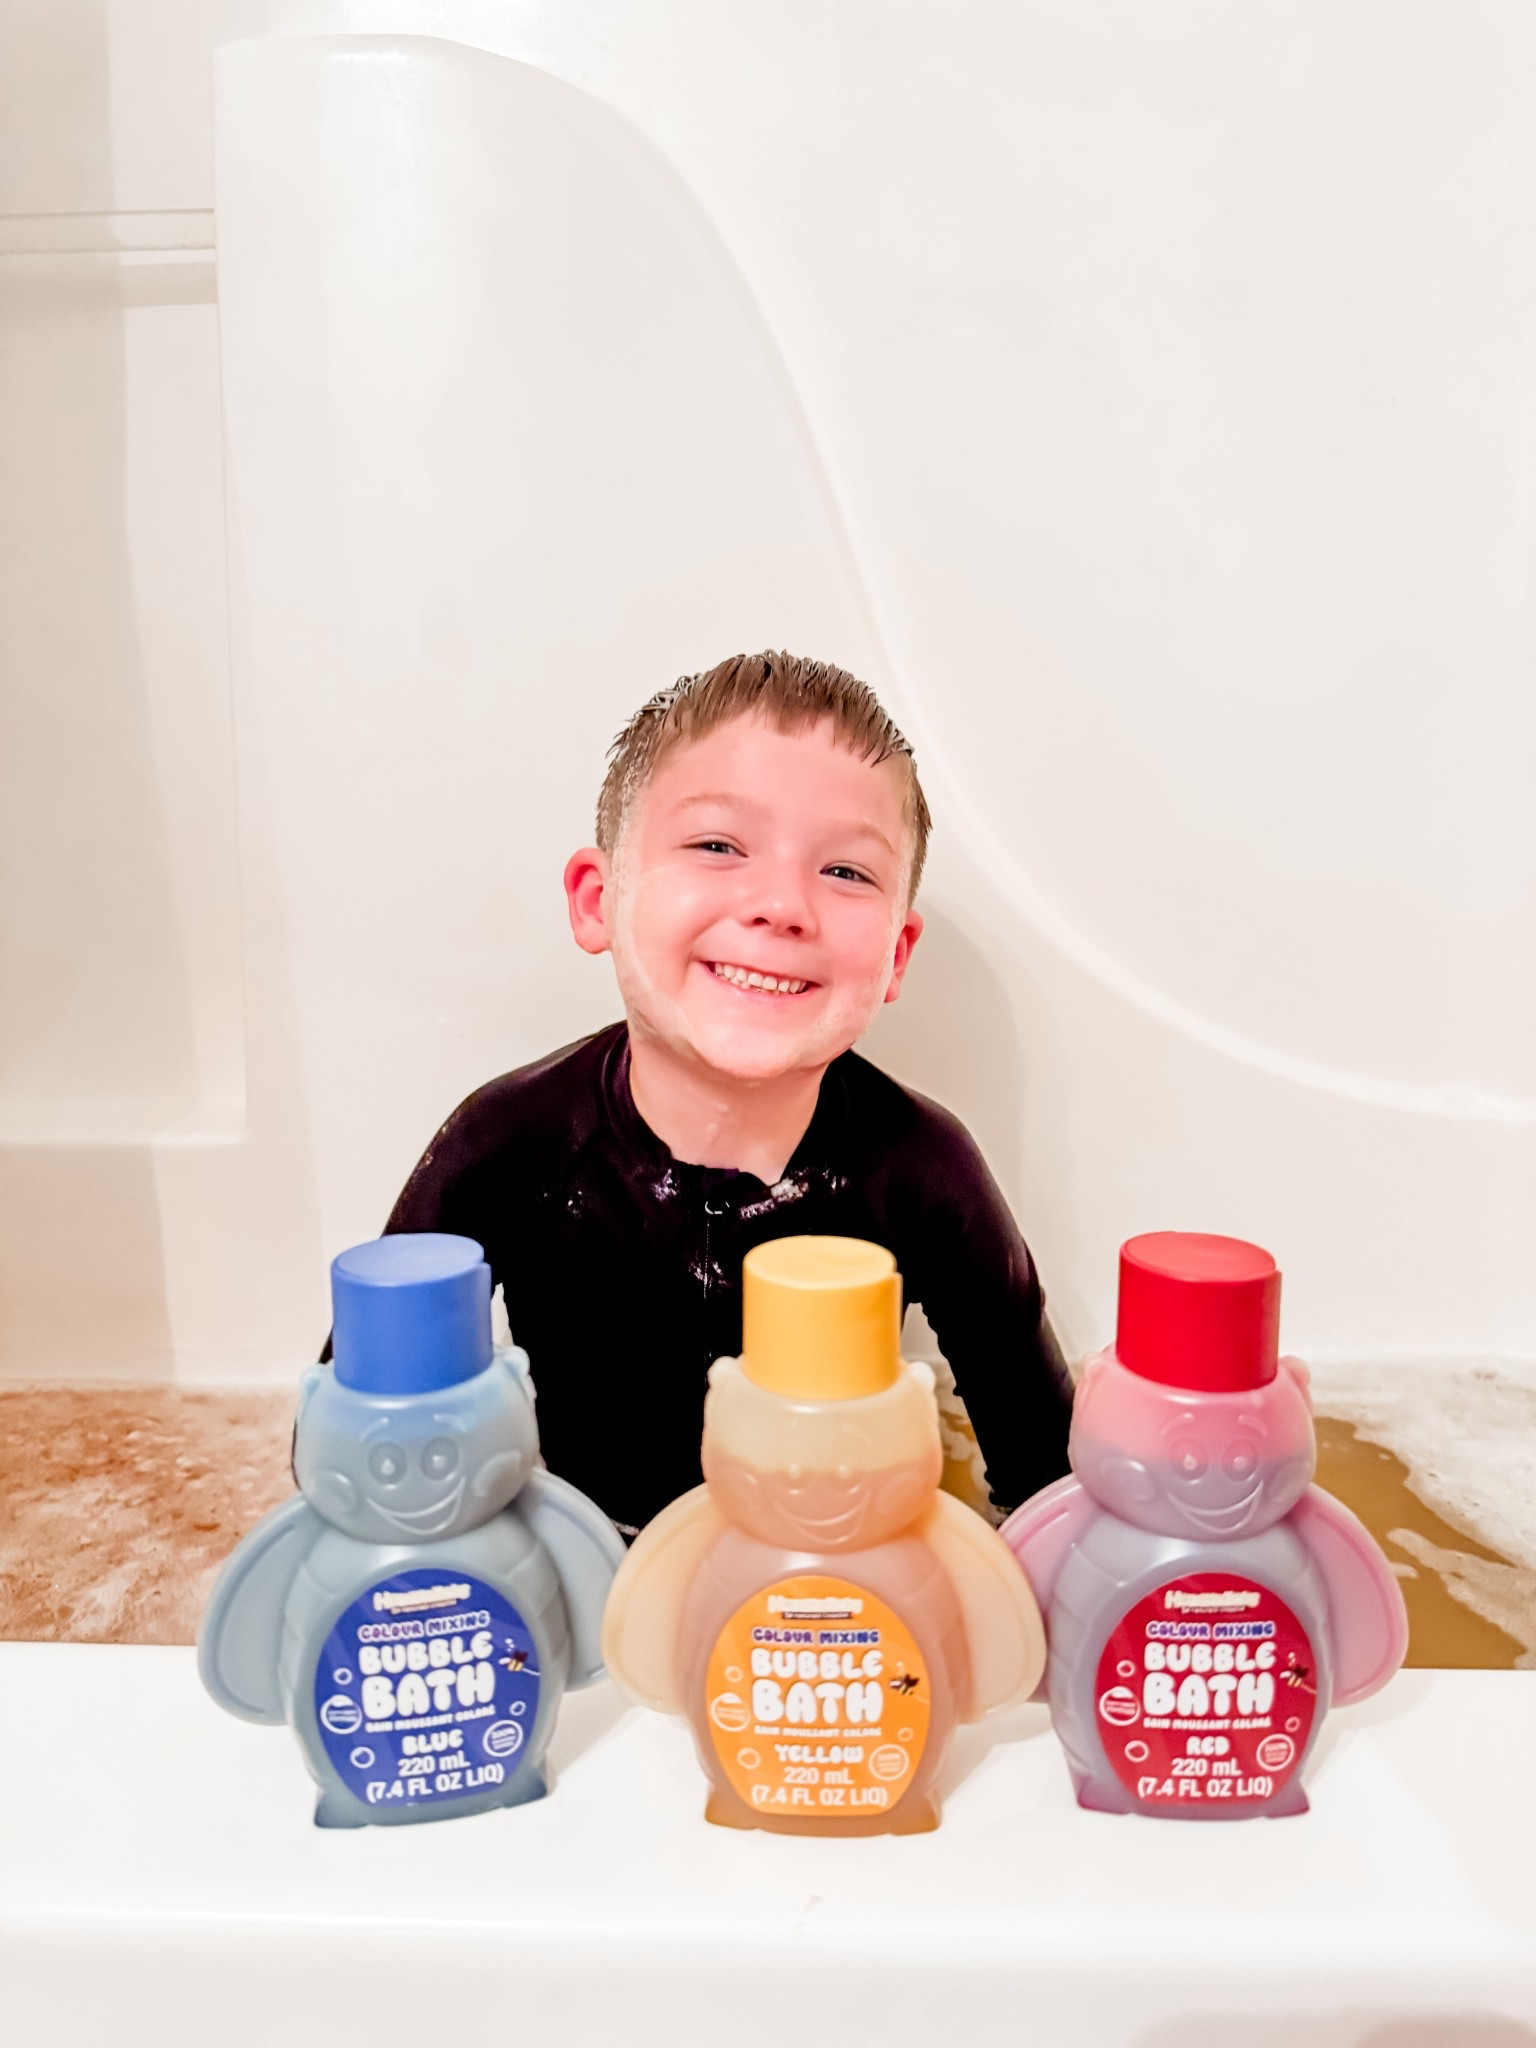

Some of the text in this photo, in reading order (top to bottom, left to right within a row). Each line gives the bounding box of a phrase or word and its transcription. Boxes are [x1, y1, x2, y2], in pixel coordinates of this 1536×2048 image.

[358, 1610, 490, 1642] COLOUR MIXING
[753, 1627, 880, 1645] COLOUR MIXING
[1146, 1621, 1275, 1640] COLOUR MIXING
[359, 1631, 493, 1675] BUBBLE
[751, 1648, 883, 1679] BUBBLE
[1144, 1641, 1277, 1673] BUBBLE
[362, 1661, 495, 1719] BATH
[752, 1679, 884, 1723] BATH
[1143, 1672, 1274, 1716] BATH
[402, 1729, 464, 1755] BLUE
[774, 1744, 863, 1763] YELLOW
[1186, 1736, 1230, 1756] RED
[399, 1750, 470, 1777] 220 mL
[784, 1767, 854, 1784] 220 mL
[1172, 1758, 1242, 1776] 220 mL
[366, 1763, 505, 1804] (7.4 FL OZ LIQ)
[752, 1785, 888, 1807] (7.4 FL OZ LIQ)
[1138, 1777, 1273, 1798] (7.4 FL OZ LIQ)
